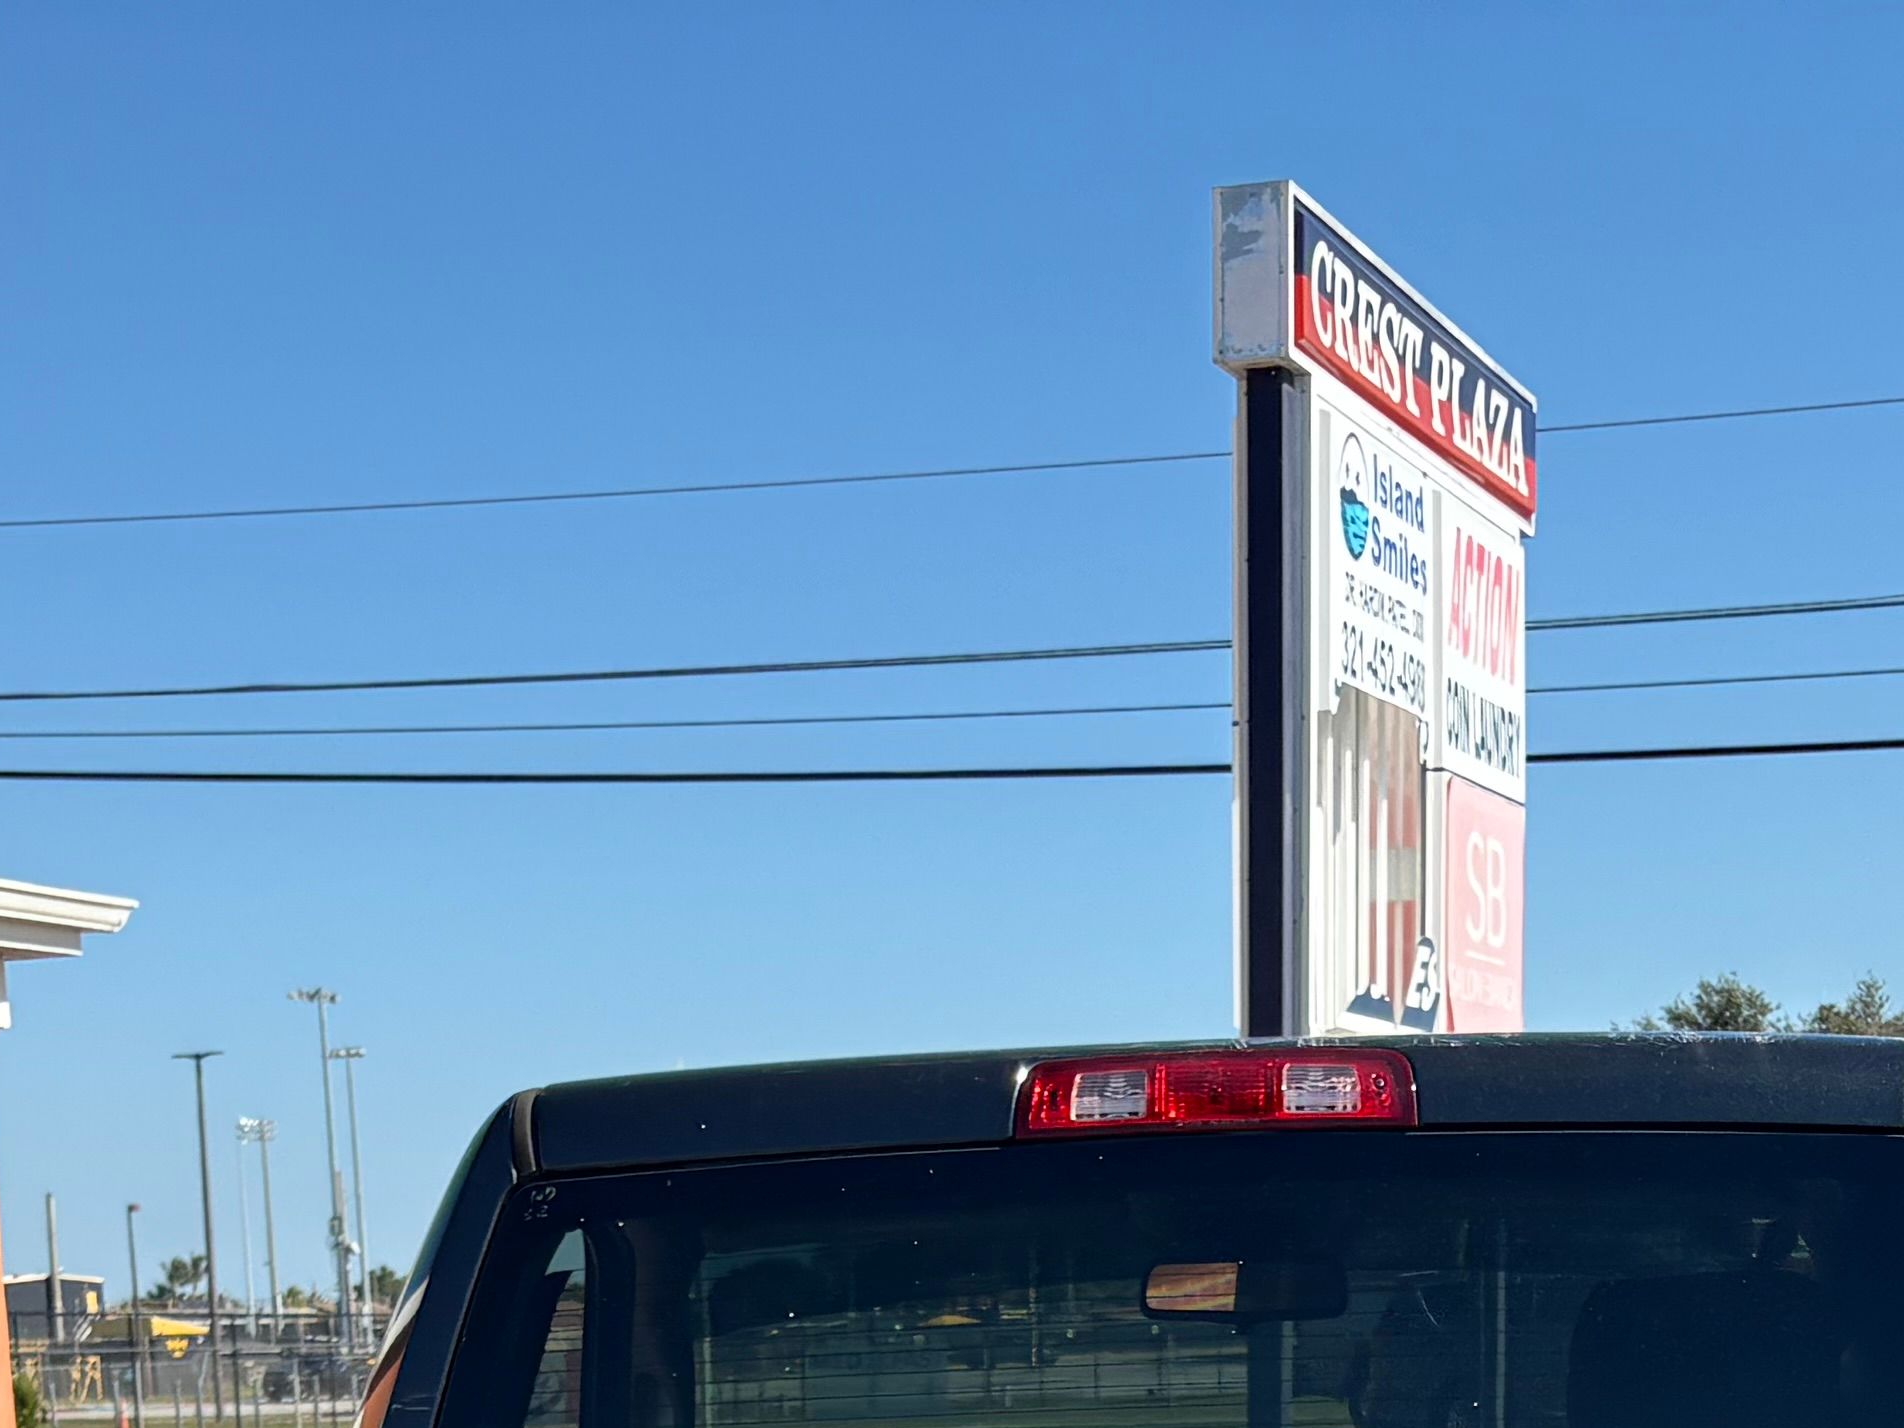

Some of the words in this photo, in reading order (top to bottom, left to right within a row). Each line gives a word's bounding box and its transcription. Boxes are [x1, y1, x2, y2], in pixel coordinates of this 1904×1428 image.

[1311, 240, 1424, 417] CREST
[1429, 341, 1529, 497] PLAZA
[1373, 453, 1425, 534] Island
[1371, 515, 1427, 597] Smiles
[1448, 526, 1520, 686] ACTION
[1447, 677, 1470, 756] COIN
[1472, 692, 1521, 778] LAUNDRY
[1465, 830, 1507, 948] SB
